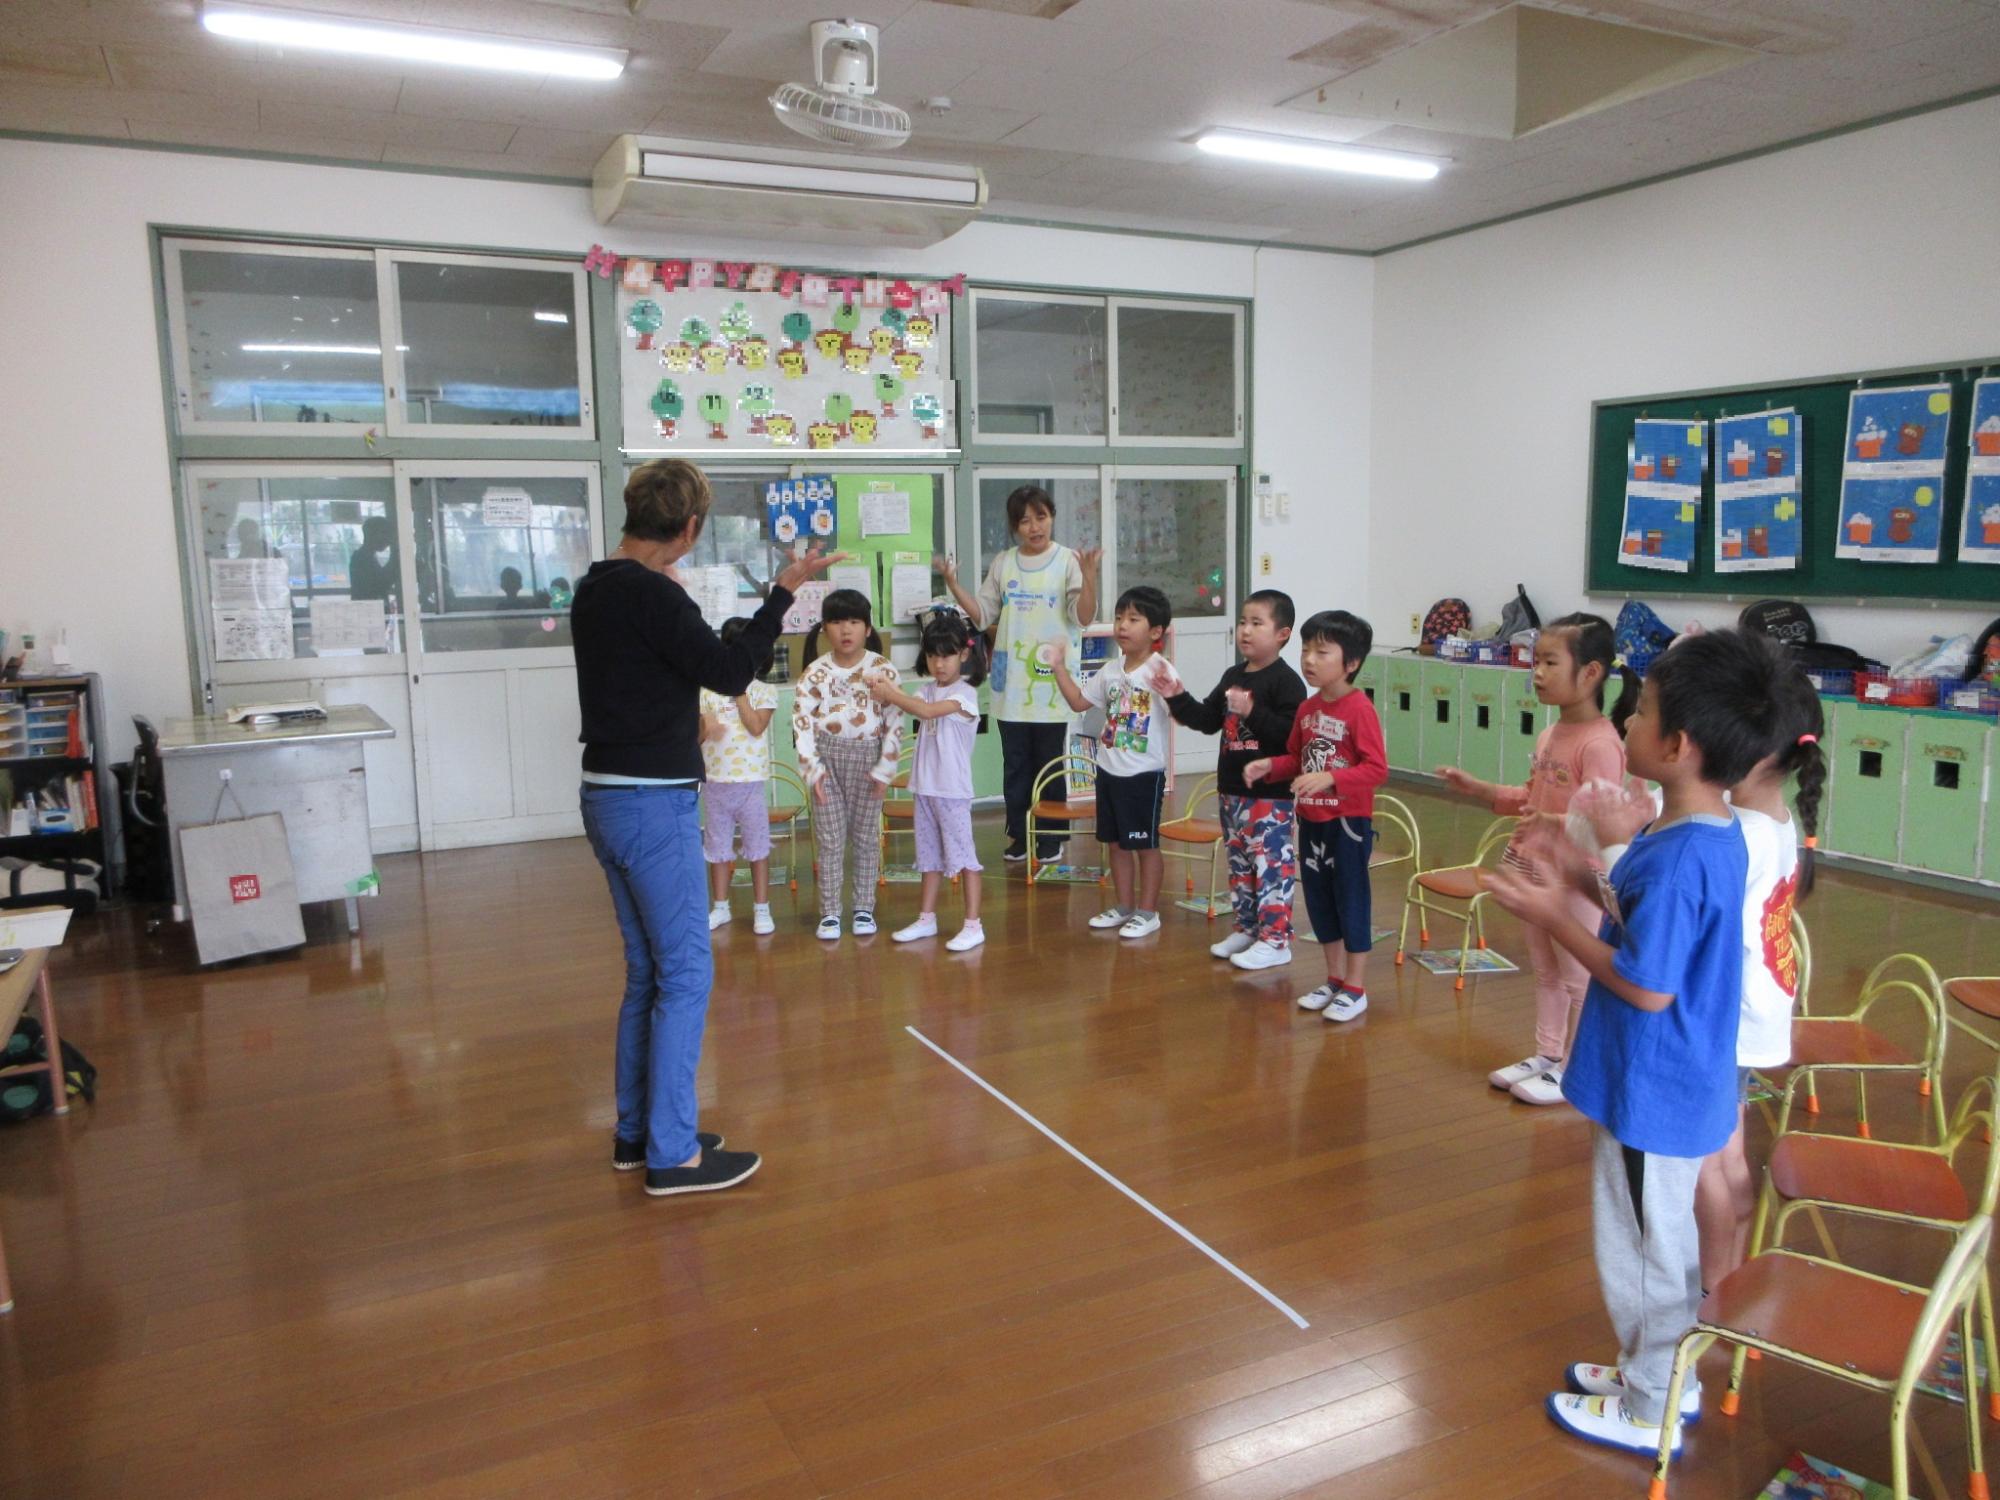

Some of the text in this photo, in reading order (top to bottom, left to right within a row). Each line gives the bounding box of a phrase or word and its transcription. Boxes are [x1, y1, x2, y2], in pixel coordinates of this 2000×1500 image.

[583, 244, 968, 315] HAPPY BIRTHDAY
[1128, 831, 1149, 839] FILA
